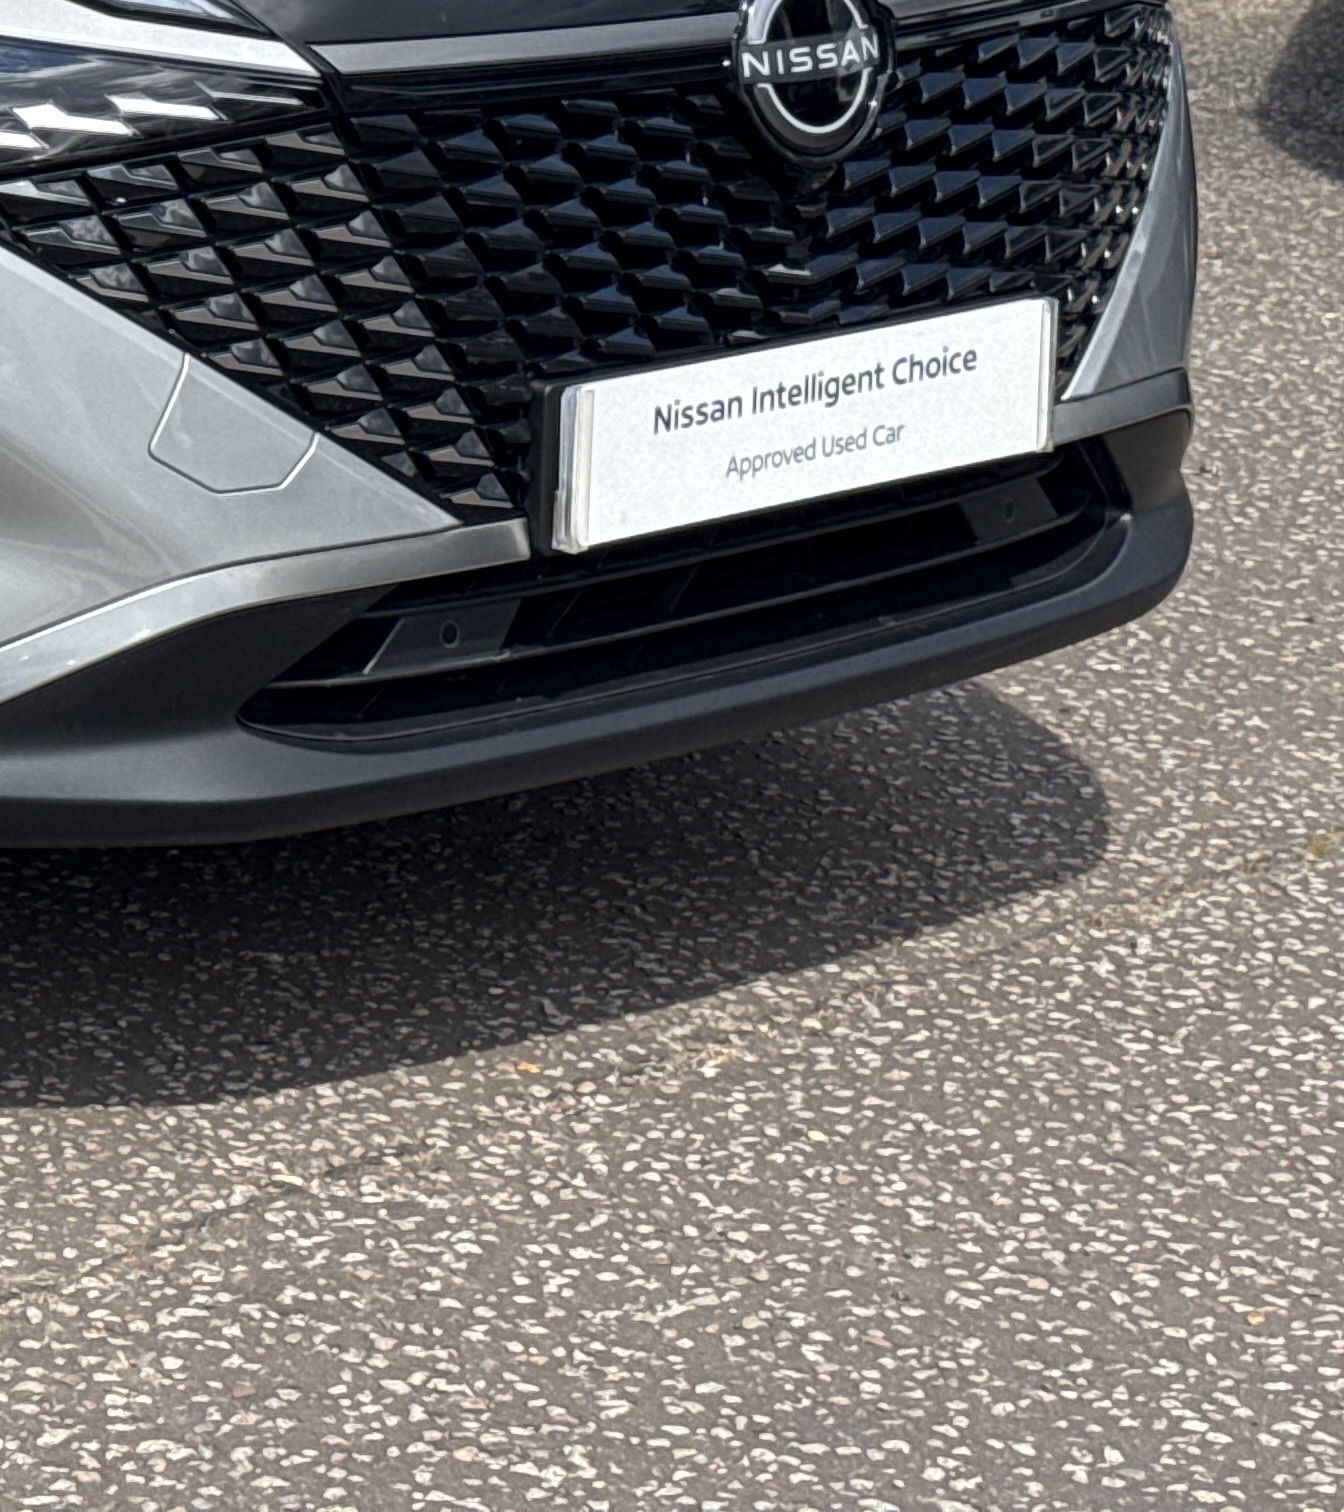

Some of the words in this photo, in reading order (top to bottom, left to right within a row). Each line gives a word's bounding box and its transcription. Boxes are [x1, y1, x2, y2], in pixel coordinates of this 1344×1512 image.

[741, 31, 880, 78] NISSAN
[653, 395, 743, 435] Nissan
[751, 362, 885, 415] Intelligent
[892, 345, 978, 385] Choice
[725, 437, 817, 481] Approved
[821, 426, 868, 458] Used
[872, 424, 905, 447] Car
